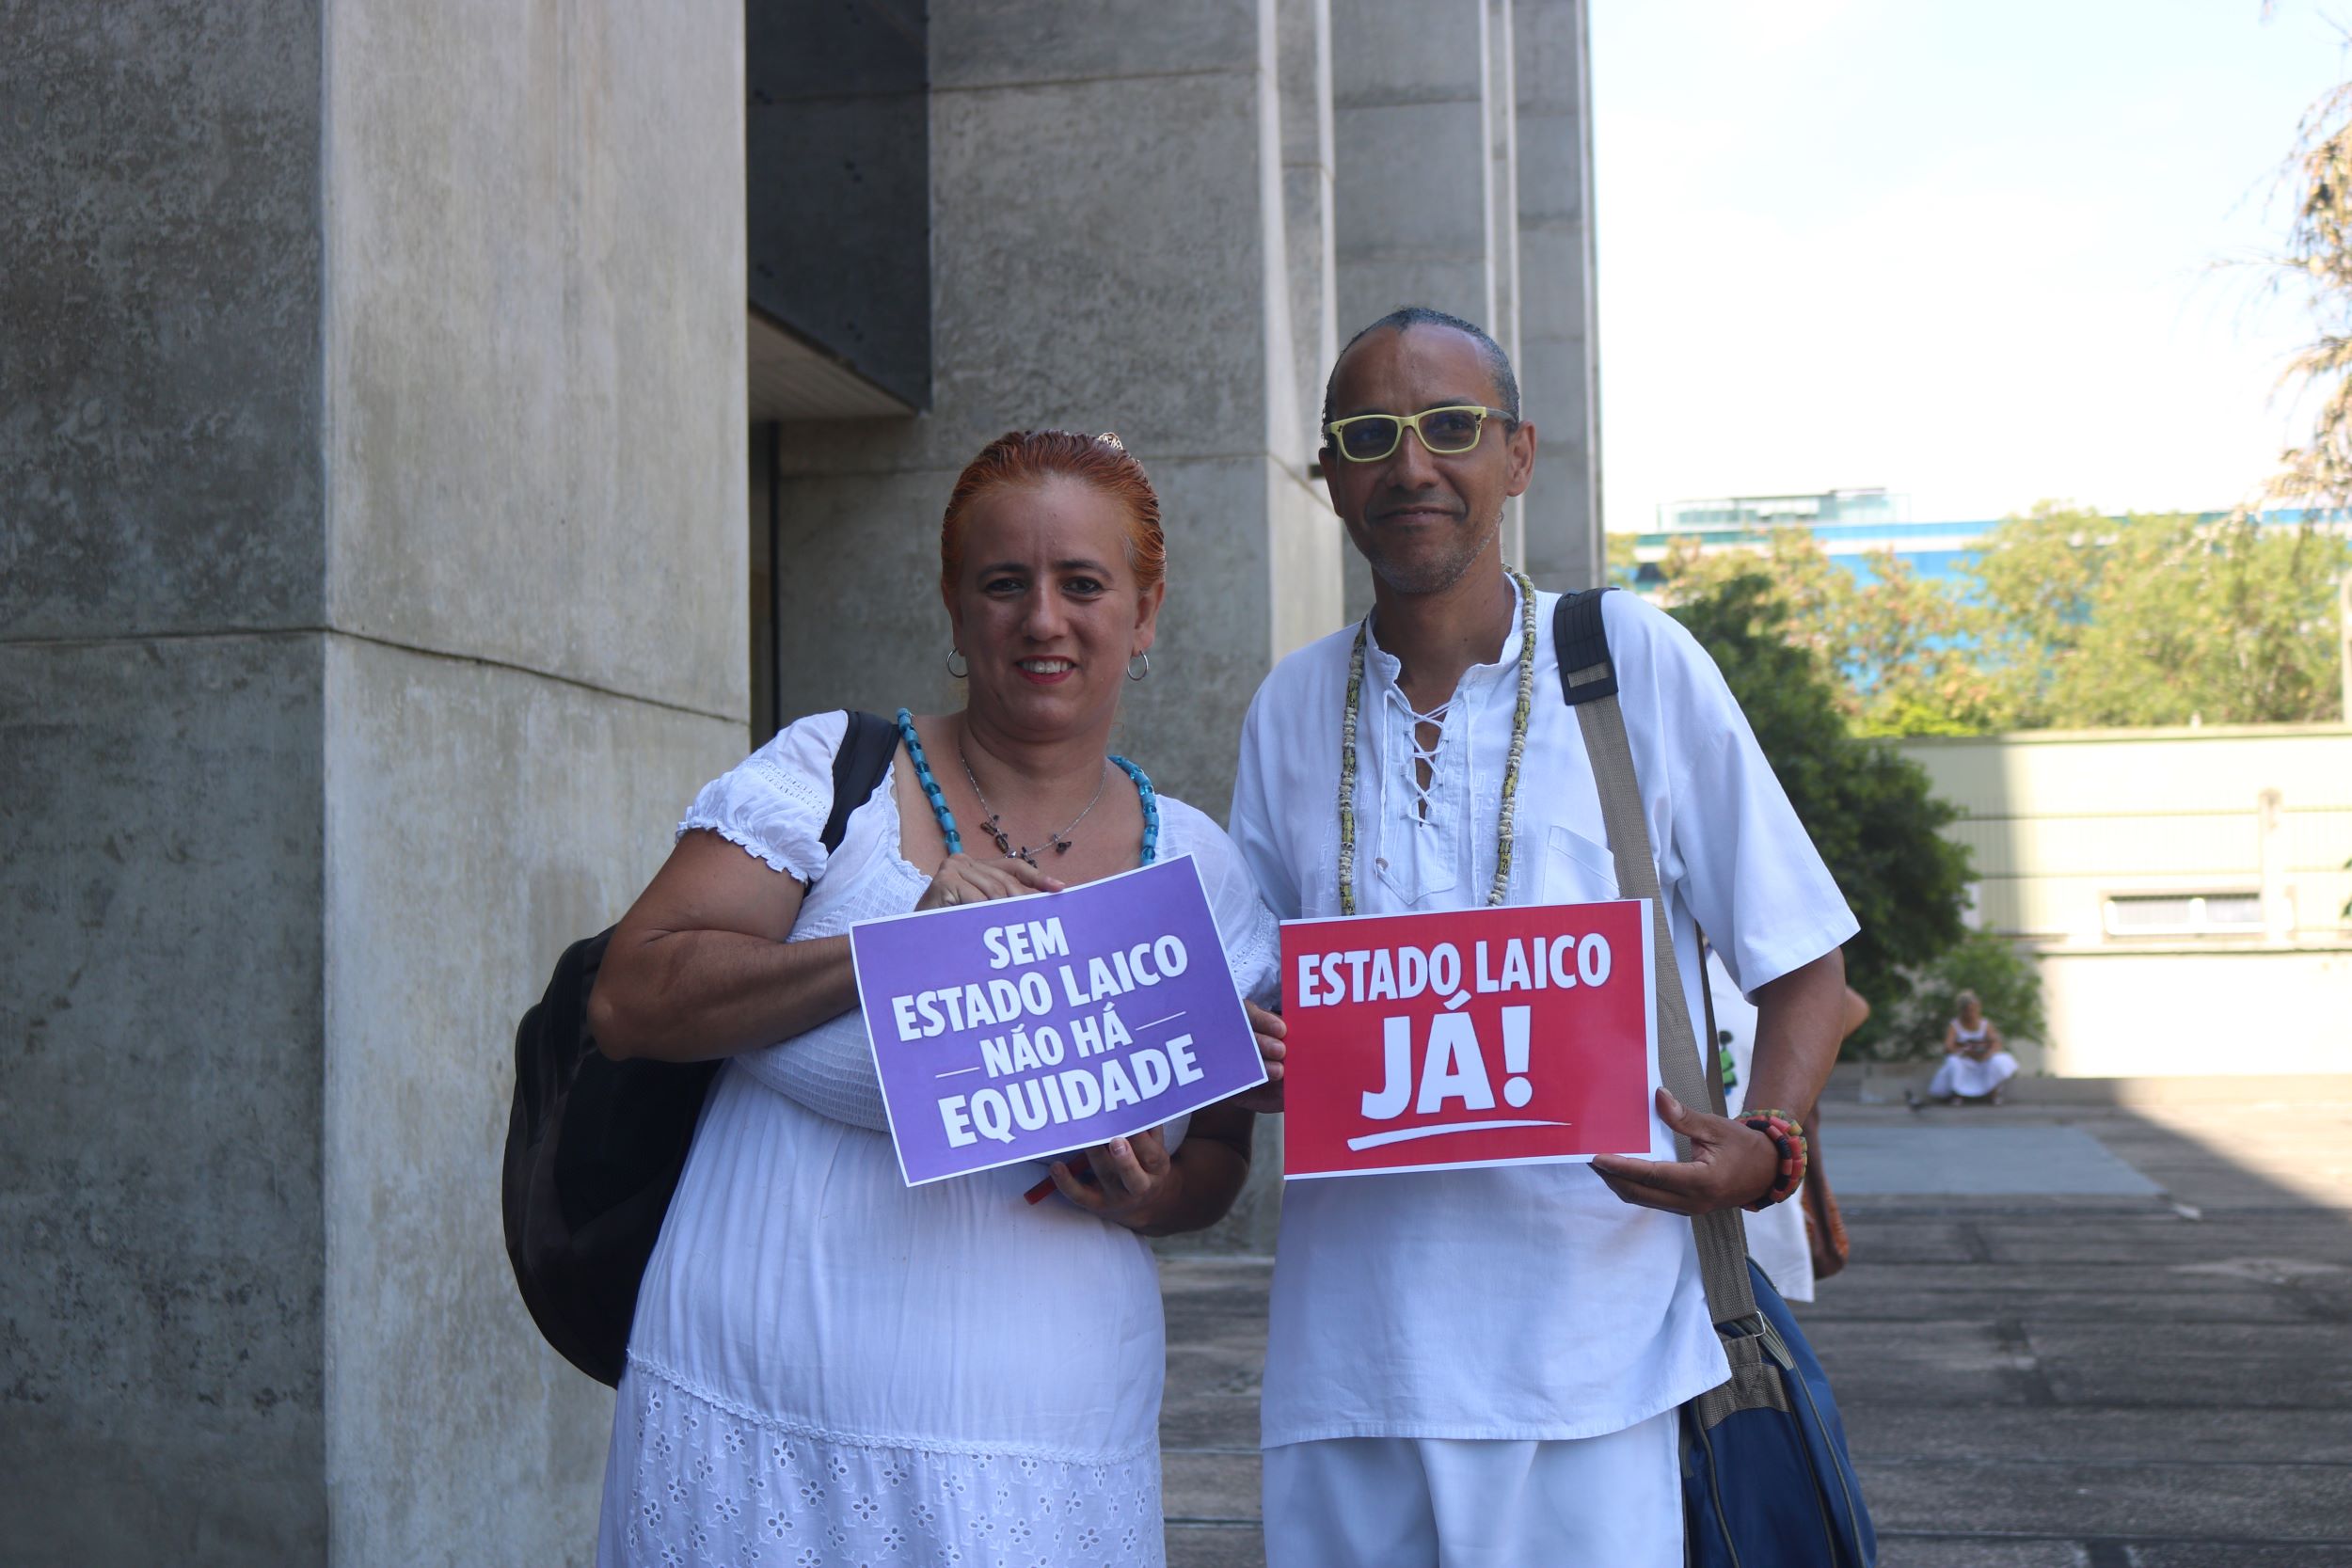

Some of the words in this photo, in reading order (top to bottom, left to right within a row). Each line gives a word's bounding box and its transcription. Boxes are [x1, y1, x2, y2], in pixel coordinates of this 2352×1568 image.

[891, 972, 1053, 1042] ESTADO
[1059, 934, 1188, 1007] LAICO
[983, 916, 1070, 969] SEM
[1298, 942, 1461, 1007] ESTADO
[1475, 933, 1612, 993] LAICO
[979, 1023, 1064, 1078] NÃO
[1070, 1002, 1133, 1059] HÁ
[1360, 990, 1533, 1120] JÁ!
[938, 1034, 1204, 1148] EQUIDADE
